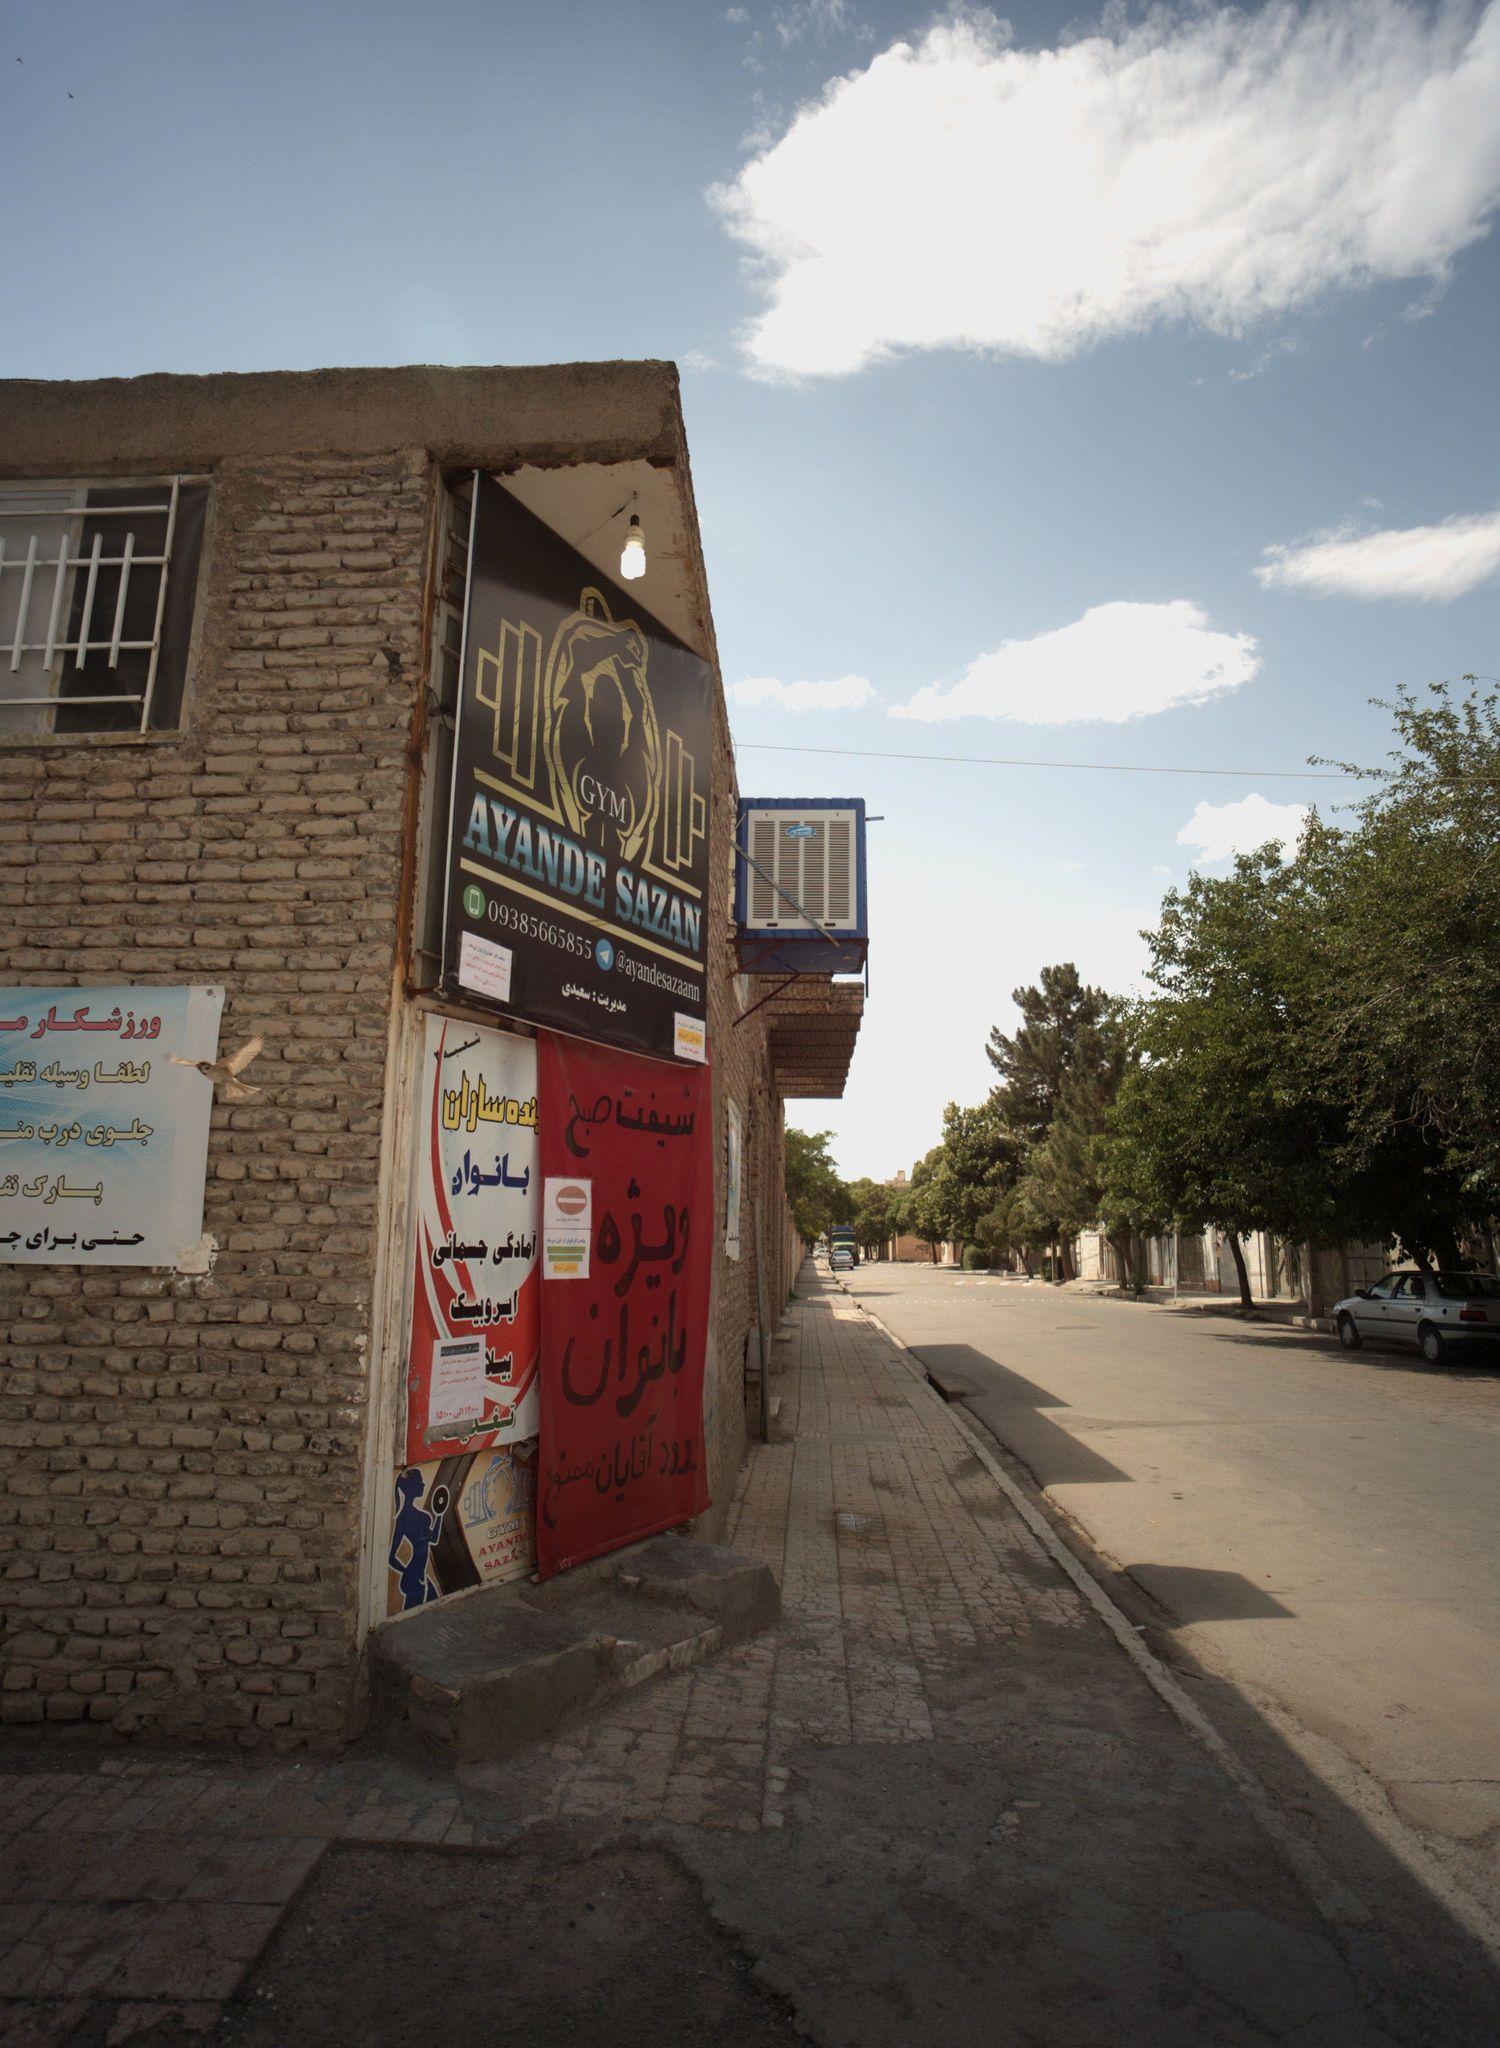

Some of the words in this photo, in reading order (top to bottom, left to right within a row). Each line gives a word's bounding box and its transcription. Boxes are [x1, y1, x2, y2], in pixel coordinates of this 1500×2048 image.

[580, 775, 627, 823] GYM
[463, 792, 607, 909] AYANDE
[615, 867, 702, 951] SAZAN
[488, 900, 592, 960] 09385665855
[616, 950, 700, 1002] @ayandesazaann
[561, 983, 591, 1000] سعیدی
[597, 993, 627, 1012] مدیریت
[30, 1007, 162, 1039] ورزشکار
[0, 1061, 36, 1087] نقلی
[40, 1061, 90, 1089] وسیله
[94, 1060, 151, 1083] لطفا
[38, 1121, 82, 1146] درب
[86, 1118, 153, 1146] جلوی
[451, 1149, 530, 1196] بانوان
[22, 1174, 103, 1205] پارک
[26, 1227, 76, 1250] برای
[81, 1230, 145, 1251] حتی
[433, 1232, 489, 1267] جسمانی
[493, 1231, 537, 1266] آمادگی
[597, 1177, 690, 1297] ویژه
[451, 1289, 518, 1325] ایروبیک
[561, 1289, 687, 1418] بانوان
[487, 1519, 521, 1540] GYM
